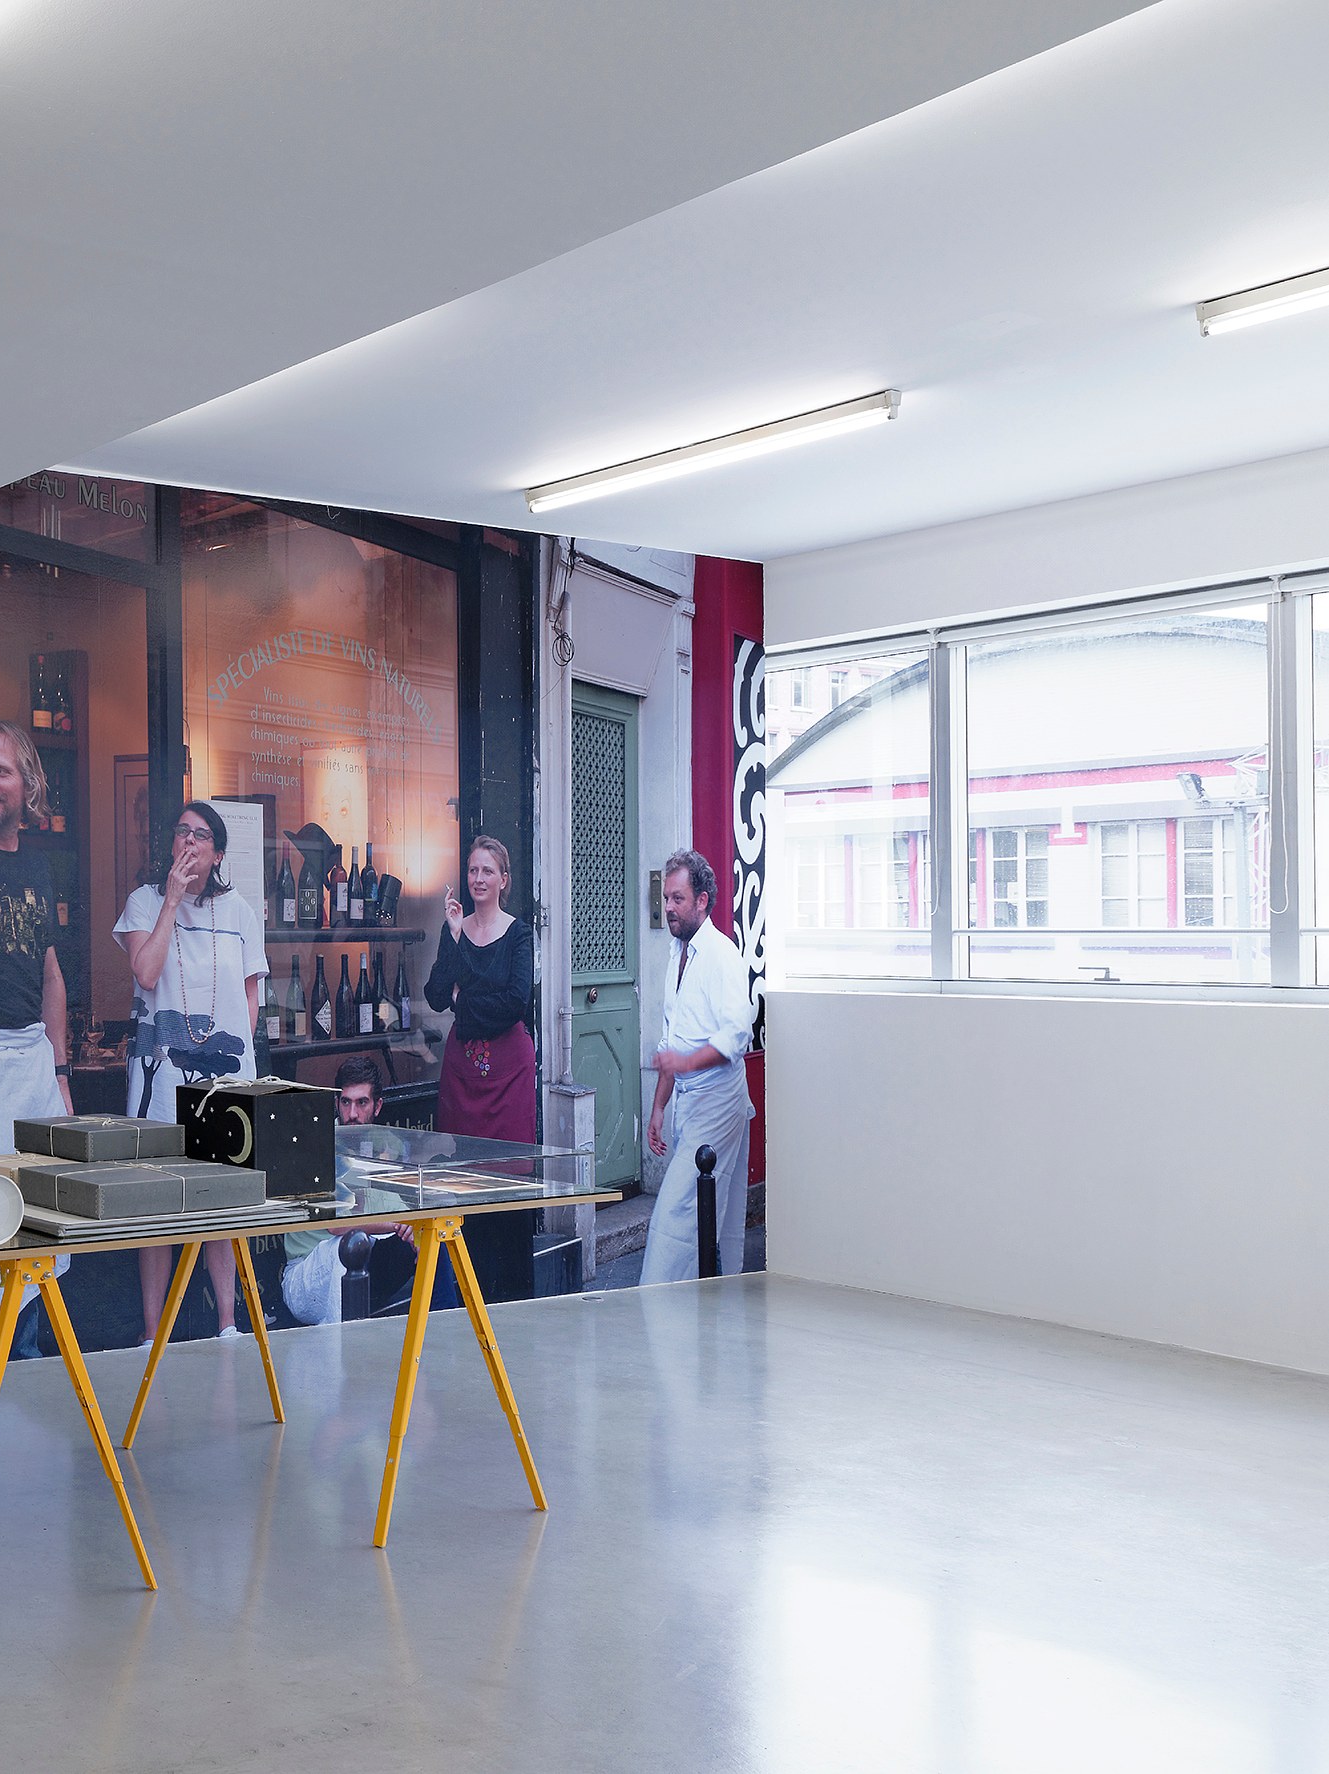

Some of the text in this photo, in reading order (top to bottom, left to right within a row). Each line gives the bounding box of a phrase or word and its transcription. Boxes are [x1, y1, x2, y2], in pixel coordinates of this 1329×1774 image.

[312, 629, 336, 656] DE
[339, 635, 377, 671] VINS
[263, 686, 283, 703] Vins
[250, 724, 299, 750] chimiques
[251, 748, 292, 765] synthèse
[345, 763, 364, 775] sans
